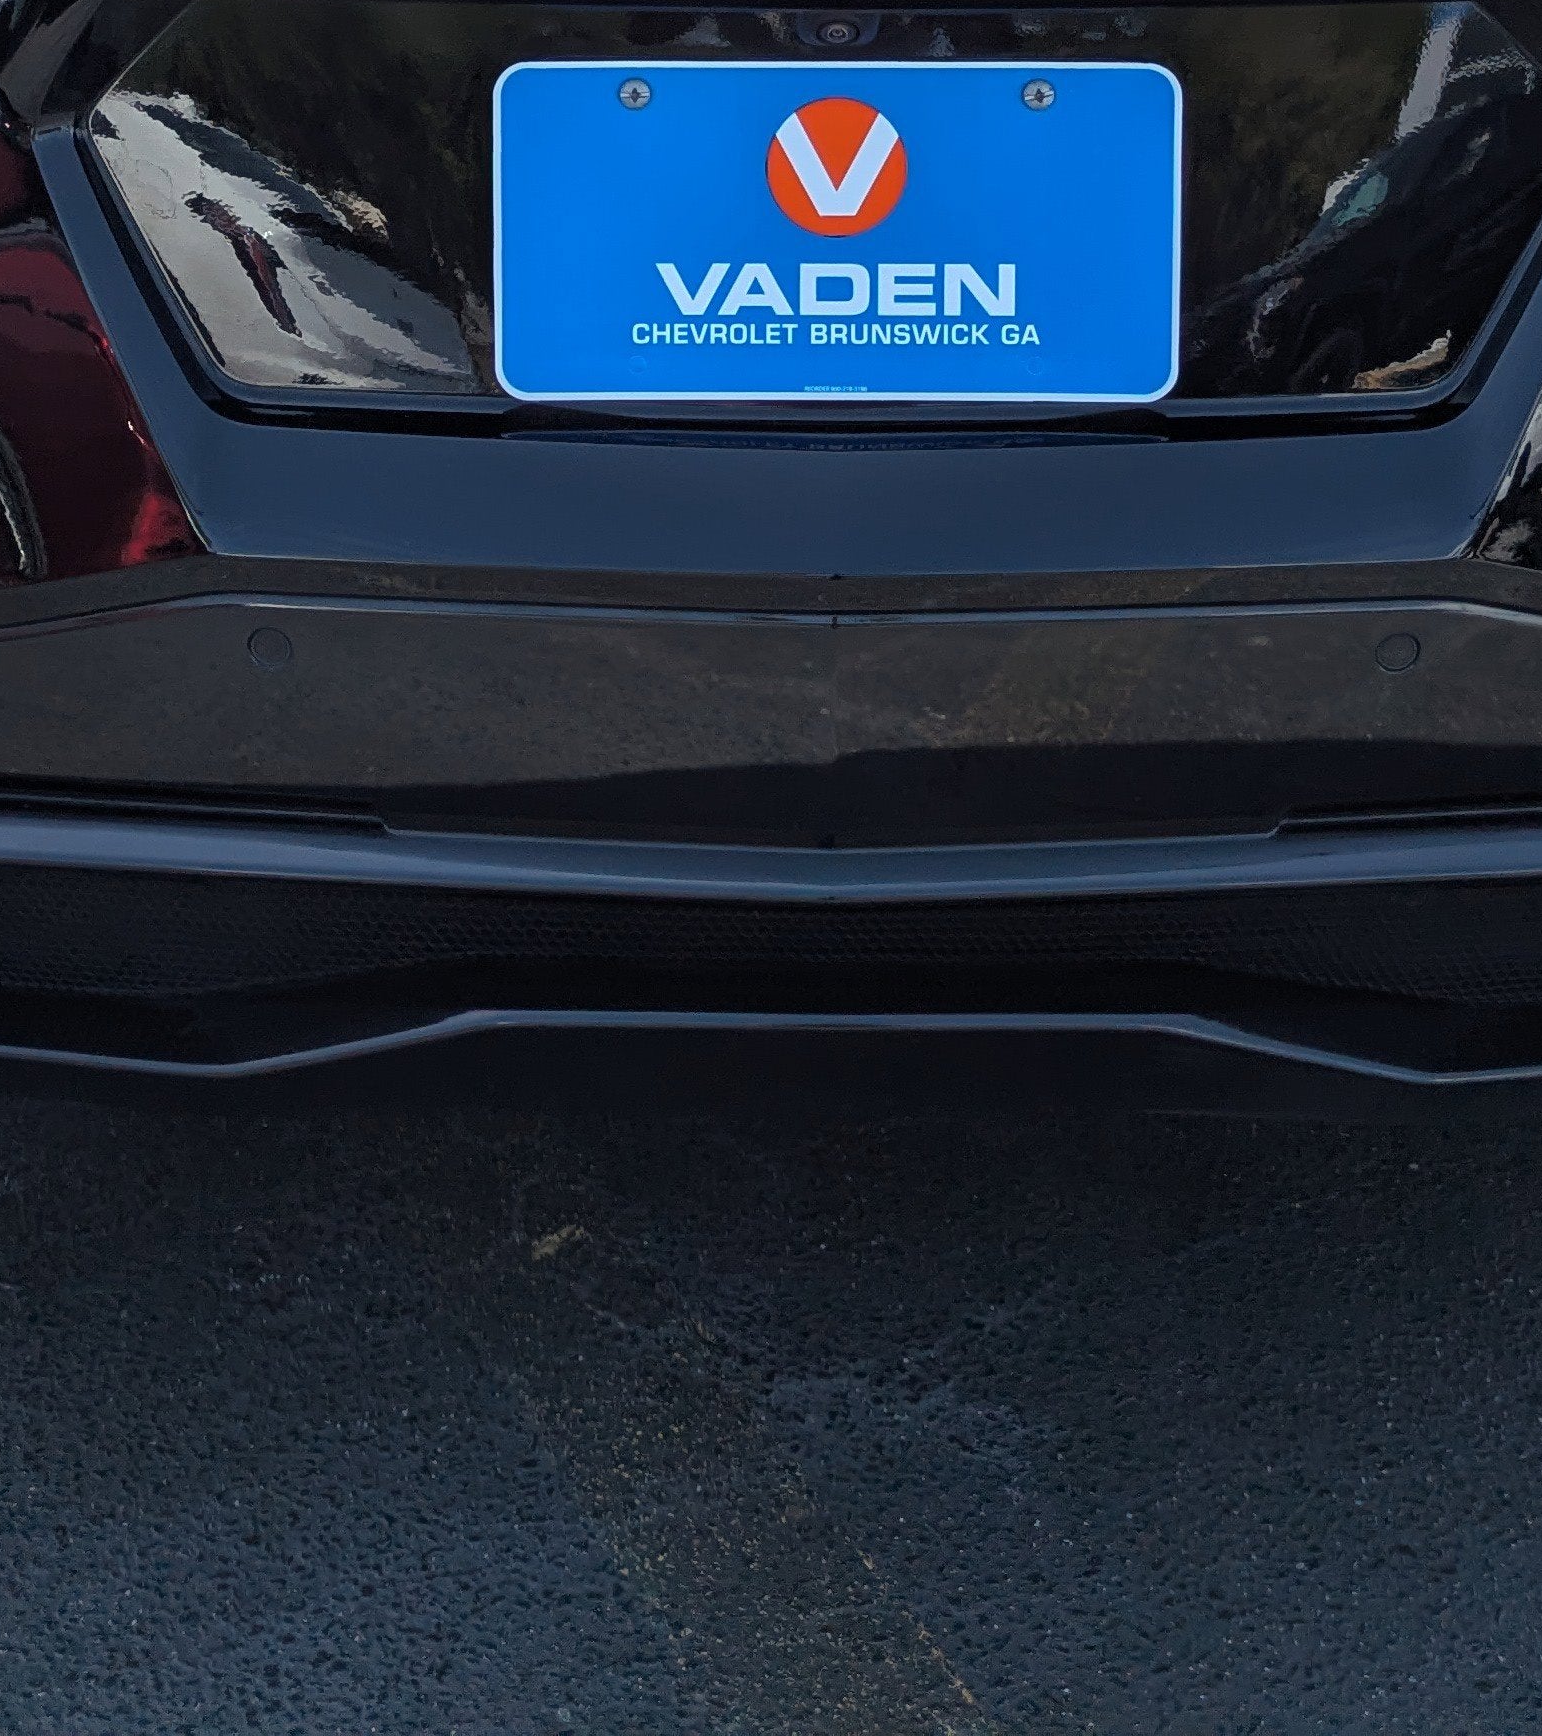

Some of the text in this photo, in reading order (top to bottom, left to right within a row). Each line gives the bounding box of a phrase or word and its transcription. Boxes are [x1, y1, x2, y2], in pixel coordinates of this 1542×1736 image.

[775, 111, 900, 217] V
[655, 262, 1016, 317] VADEN
[631, 322, 1041, 345] CHEVROLET BRUNSWICK GA
